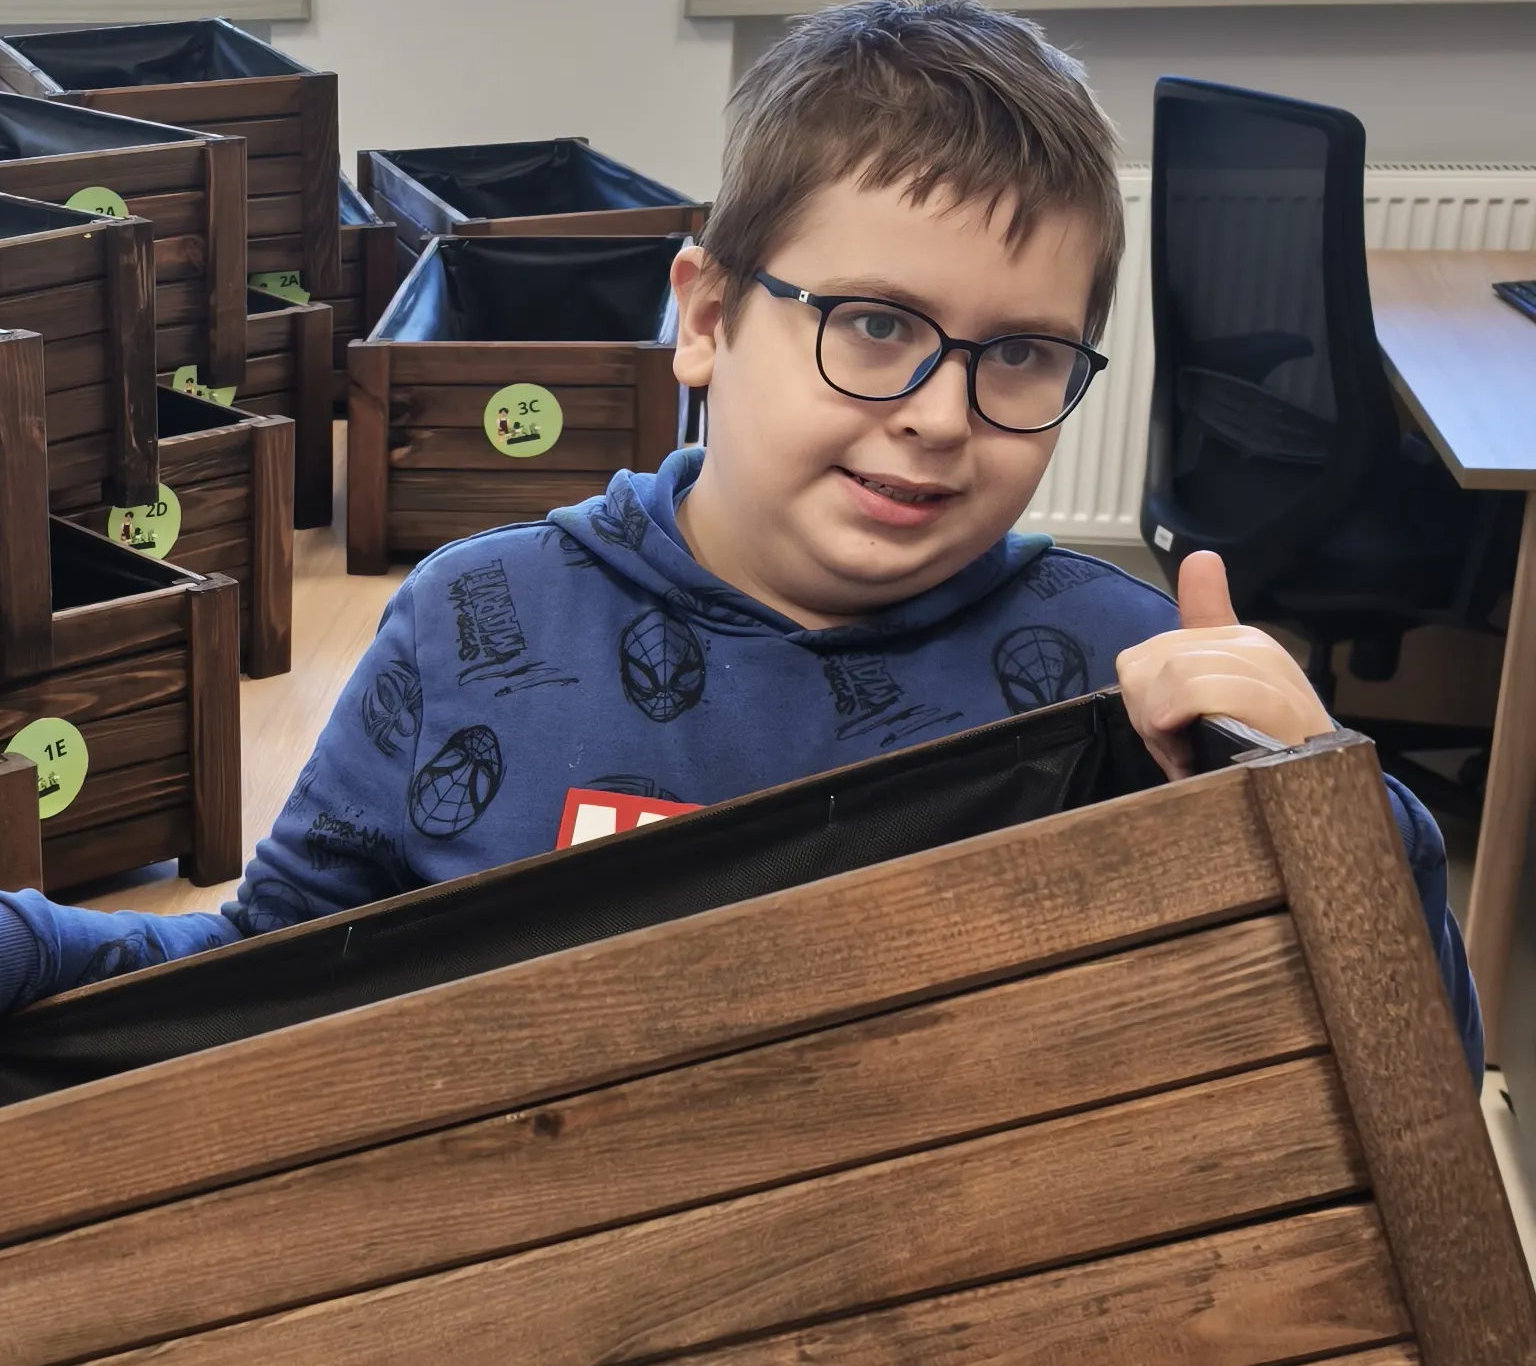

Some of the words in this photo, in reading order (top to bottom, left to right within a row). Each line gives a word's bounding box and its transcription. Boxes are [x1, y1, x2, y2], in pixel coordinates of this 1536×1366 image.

[279, 274, 299, 288] 2A
[517, 399, 541, 416] 3C
[44, 738, 68, 761] 1E
